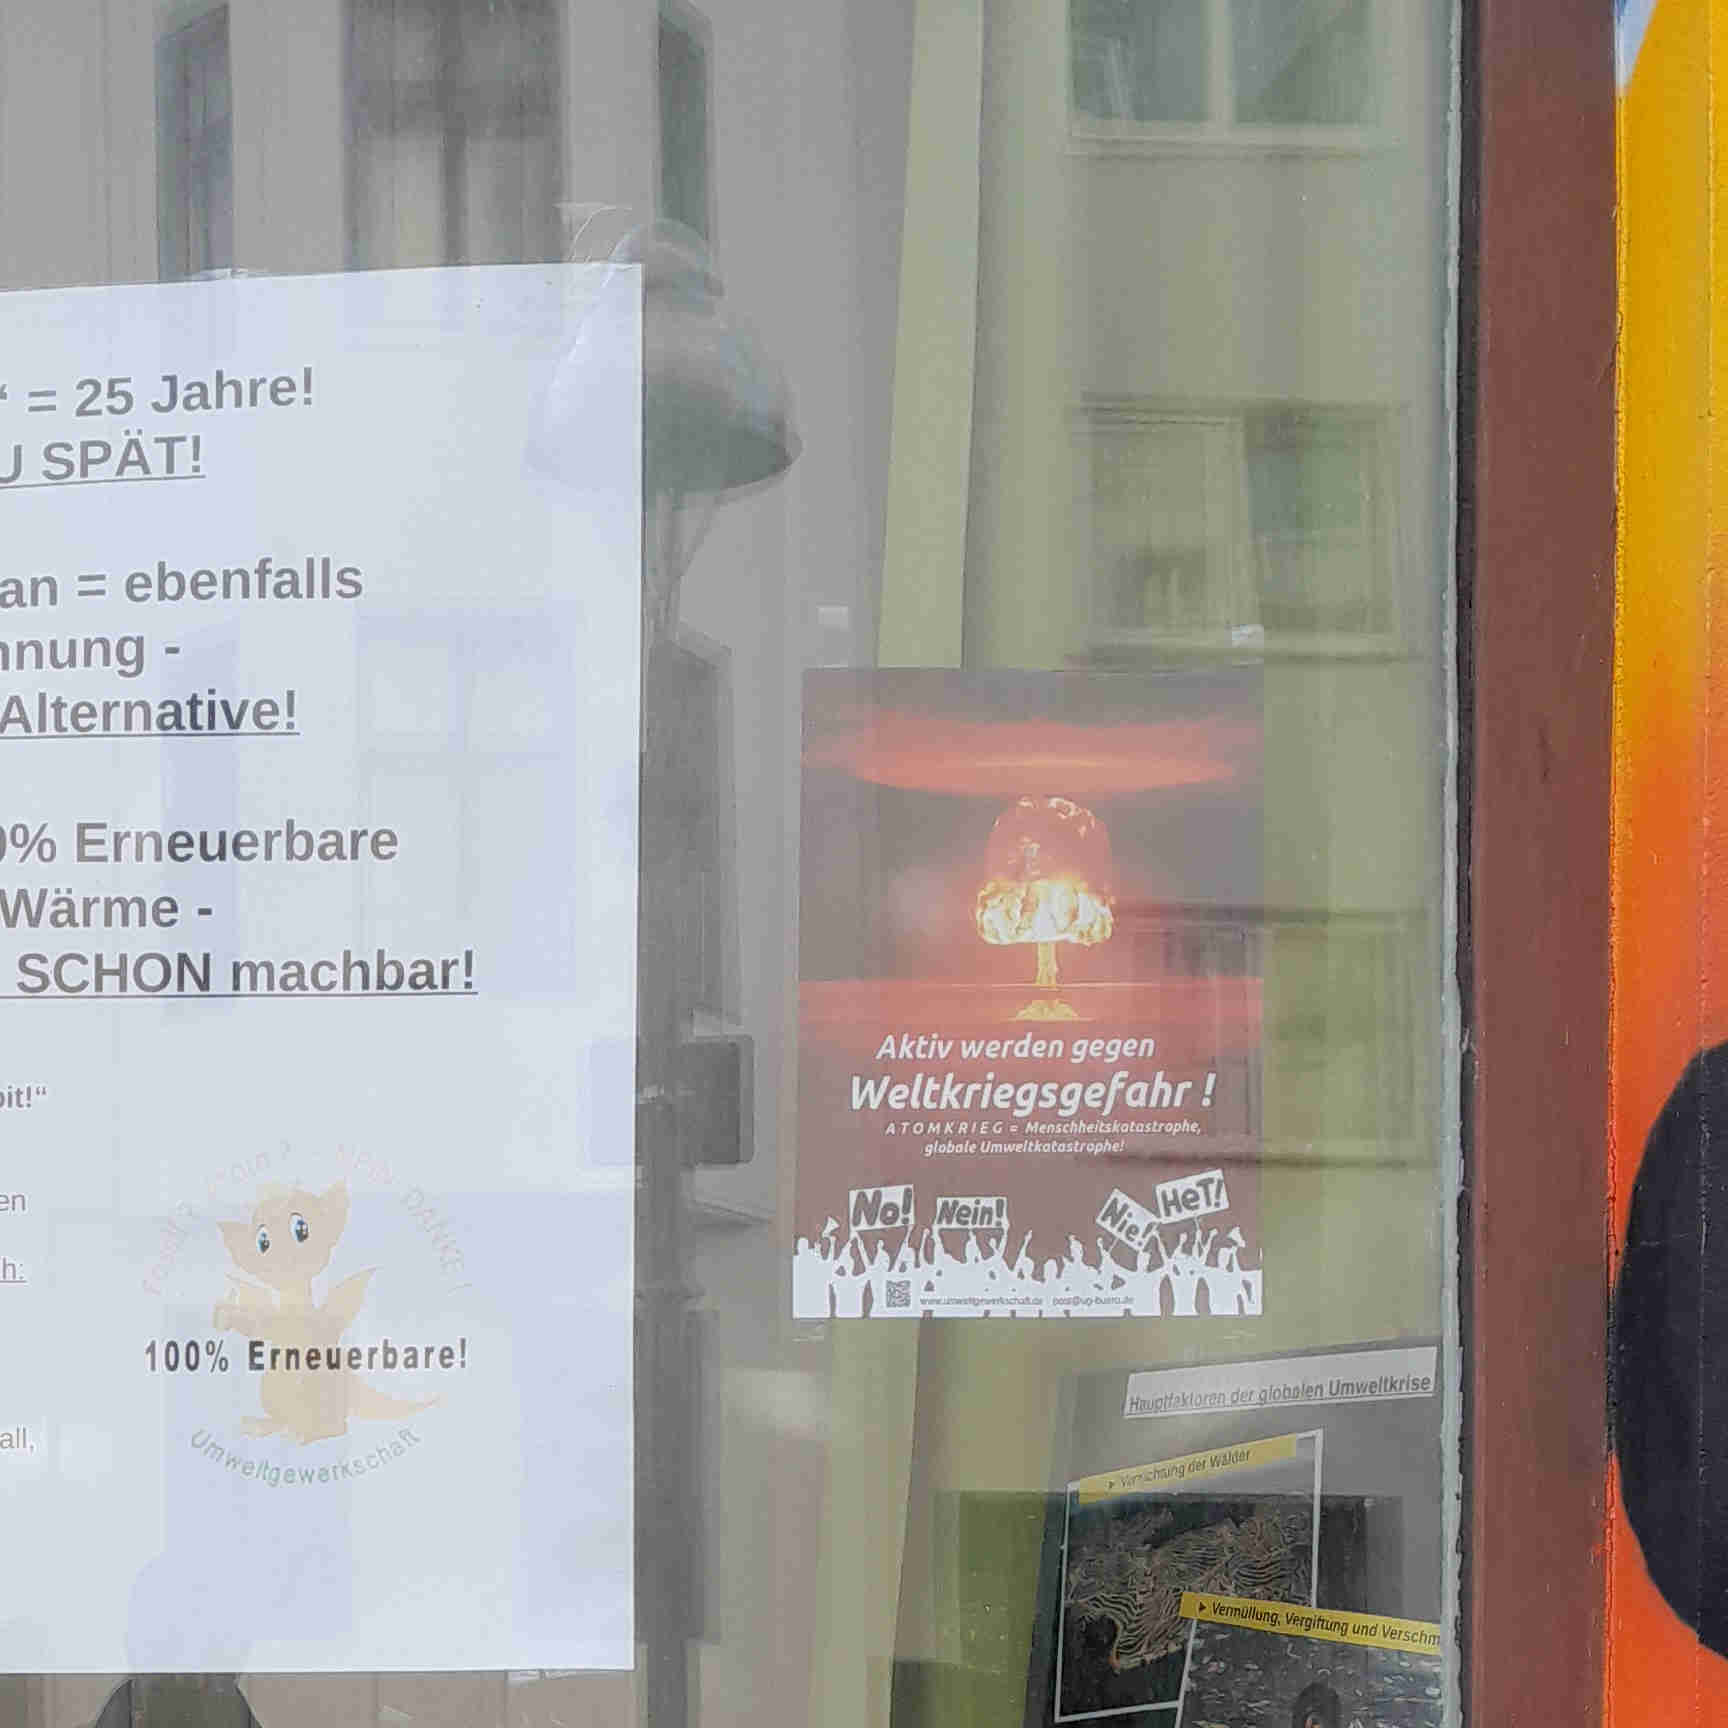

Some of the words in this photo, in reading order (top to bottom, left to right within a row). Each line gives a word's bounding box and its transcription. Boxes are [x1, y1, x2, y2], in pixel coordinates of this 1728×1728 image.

[27, 390, 57, 413] =
[75, 376, 134, 418] 25
[150, 366, 313, 414] Jahre!
[41, 430, 201, 481] SPÄT!
[77, 574, 107, 597] =
[124, 556, 363, 603] ebenfalls
[76, 818, 398, 863] Erneuerbare
[16, 952, 211, 994] SCHON
[231, 948, 473, 992] machbar!
[875, 1034, 953, 1060] Aktiv
[960, 1032, 1065, 1059] werden
[1070, 1038, 1156, 1063] gegen
[1024, 1119, 1203, 1136] Menschheitskatastrophe,
[923, 1140, 978, 1157] globale
[980, 1139, 1126, 1156] Umweltkatastrophe!
[852, 1187, 913, 1227] No!
[937, 1198, 1005, 1227] Nein!
[1100, 1197, 1155, 1248] Nie!
[144, 1340, 230, 1373] 100%
[248, 1337, 469, 1371] Erneuerbare!
[1327, 1375, 1432, 1397] Umweltkrise
[189, 1424, 424, 1488] Umweltgewerkschaft
[1284, 1612, 1349, 1636] Vergiftung
[1352, 1622, 1378, 1636] und
